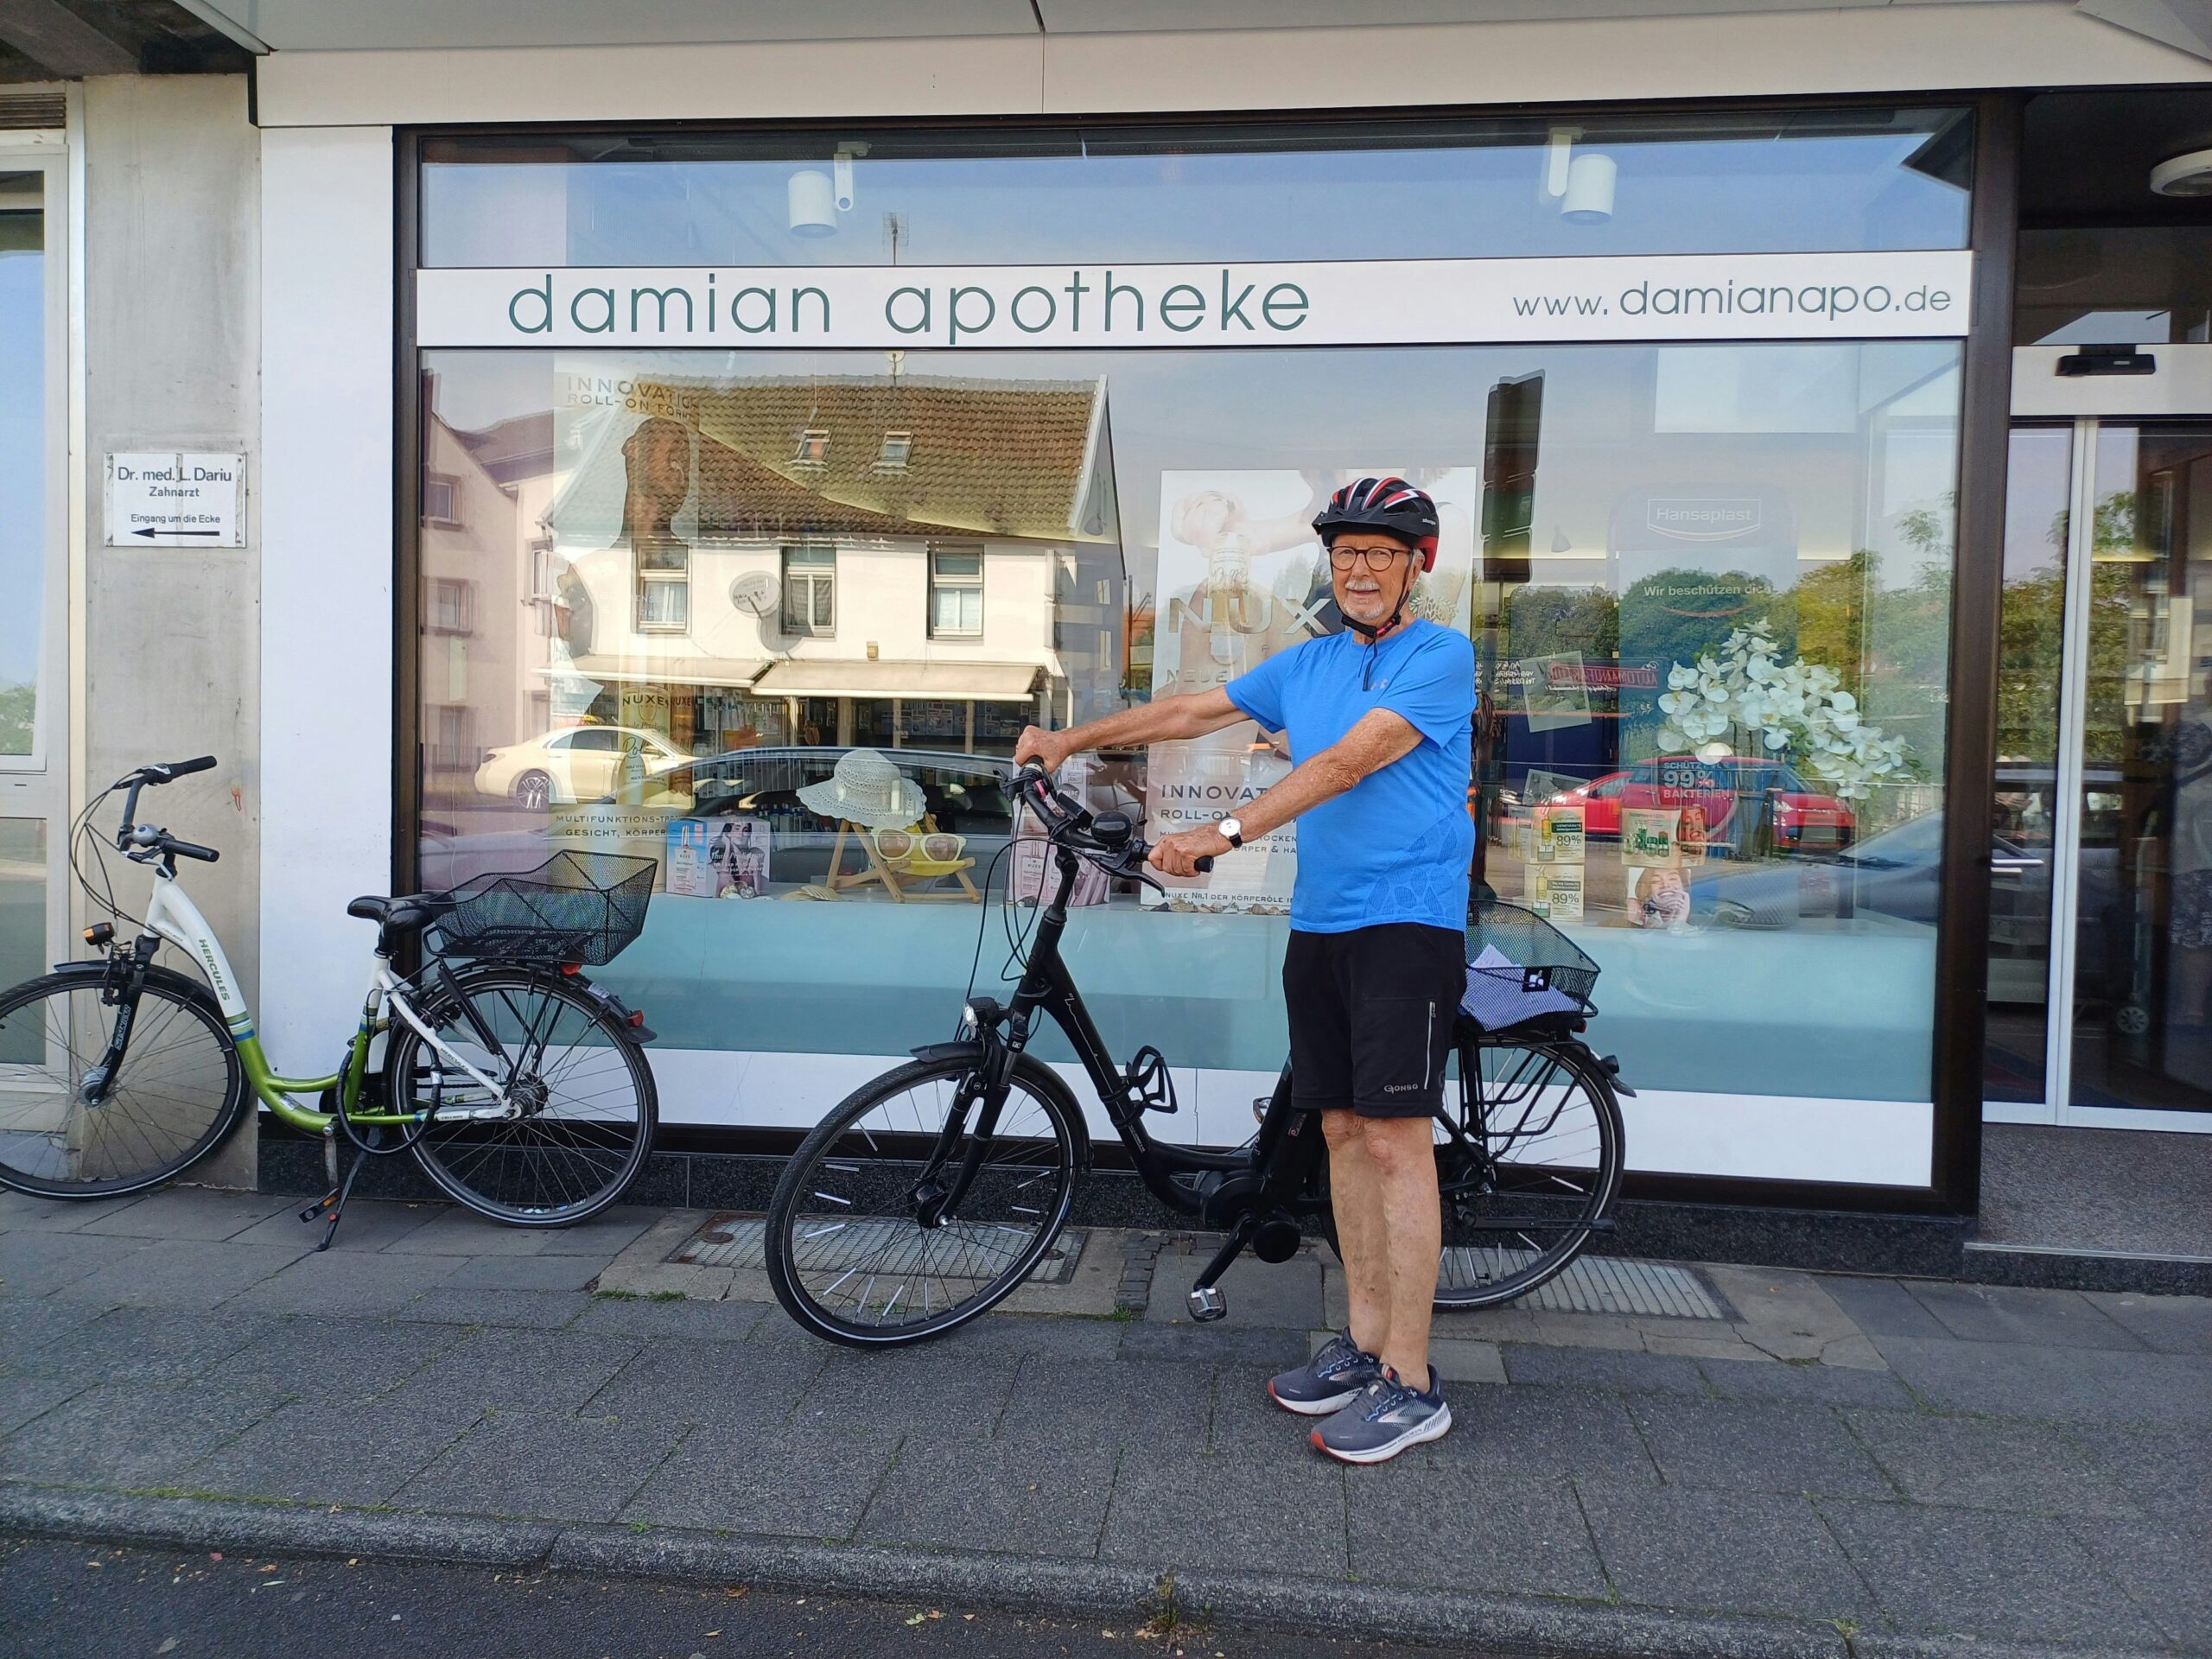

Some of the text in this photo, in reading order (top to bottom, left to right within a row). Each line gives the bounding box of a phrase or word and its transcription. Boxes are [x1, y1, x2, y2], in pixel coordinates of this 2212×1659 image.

[508, 269, 1309, 345] damian apotheke
[568, 394, 648, 410] ROLL-ON
[118, 467, 232, 481] Dr. med. L. Dariu
[149, 486, 200, 497] Zahnarzt
[130, 513, 166, 524] Eingang
[183, 514, 197, 524] die
[198, 514, 220, 524] Ecke
[1656, 508, 1752, 524] Hansaplast
[1643, 586, 1665, 596] Wir
[1668, 584, 1740, 595] beschützen
[1168, 597, 1336, 635] NUX
[623, 694, 664, 707] NUXE
[1161, 785, 1268, 800] INNOVAT
[1663, 789, 1731, 798] BAKTERIEN
[565, 829, 620, 838] GESICHT,
[1556, 835, 1581, 847] 89%
[1271, 845, 1279, 854] &
[1231, 893, 1284, 903] KÖRPERÖLE
[1552, 893, 1580, 905] 89%
[199, 939, 230, 1001] HERCULES
[1383, 1084, 1418, 1095] GONSO
